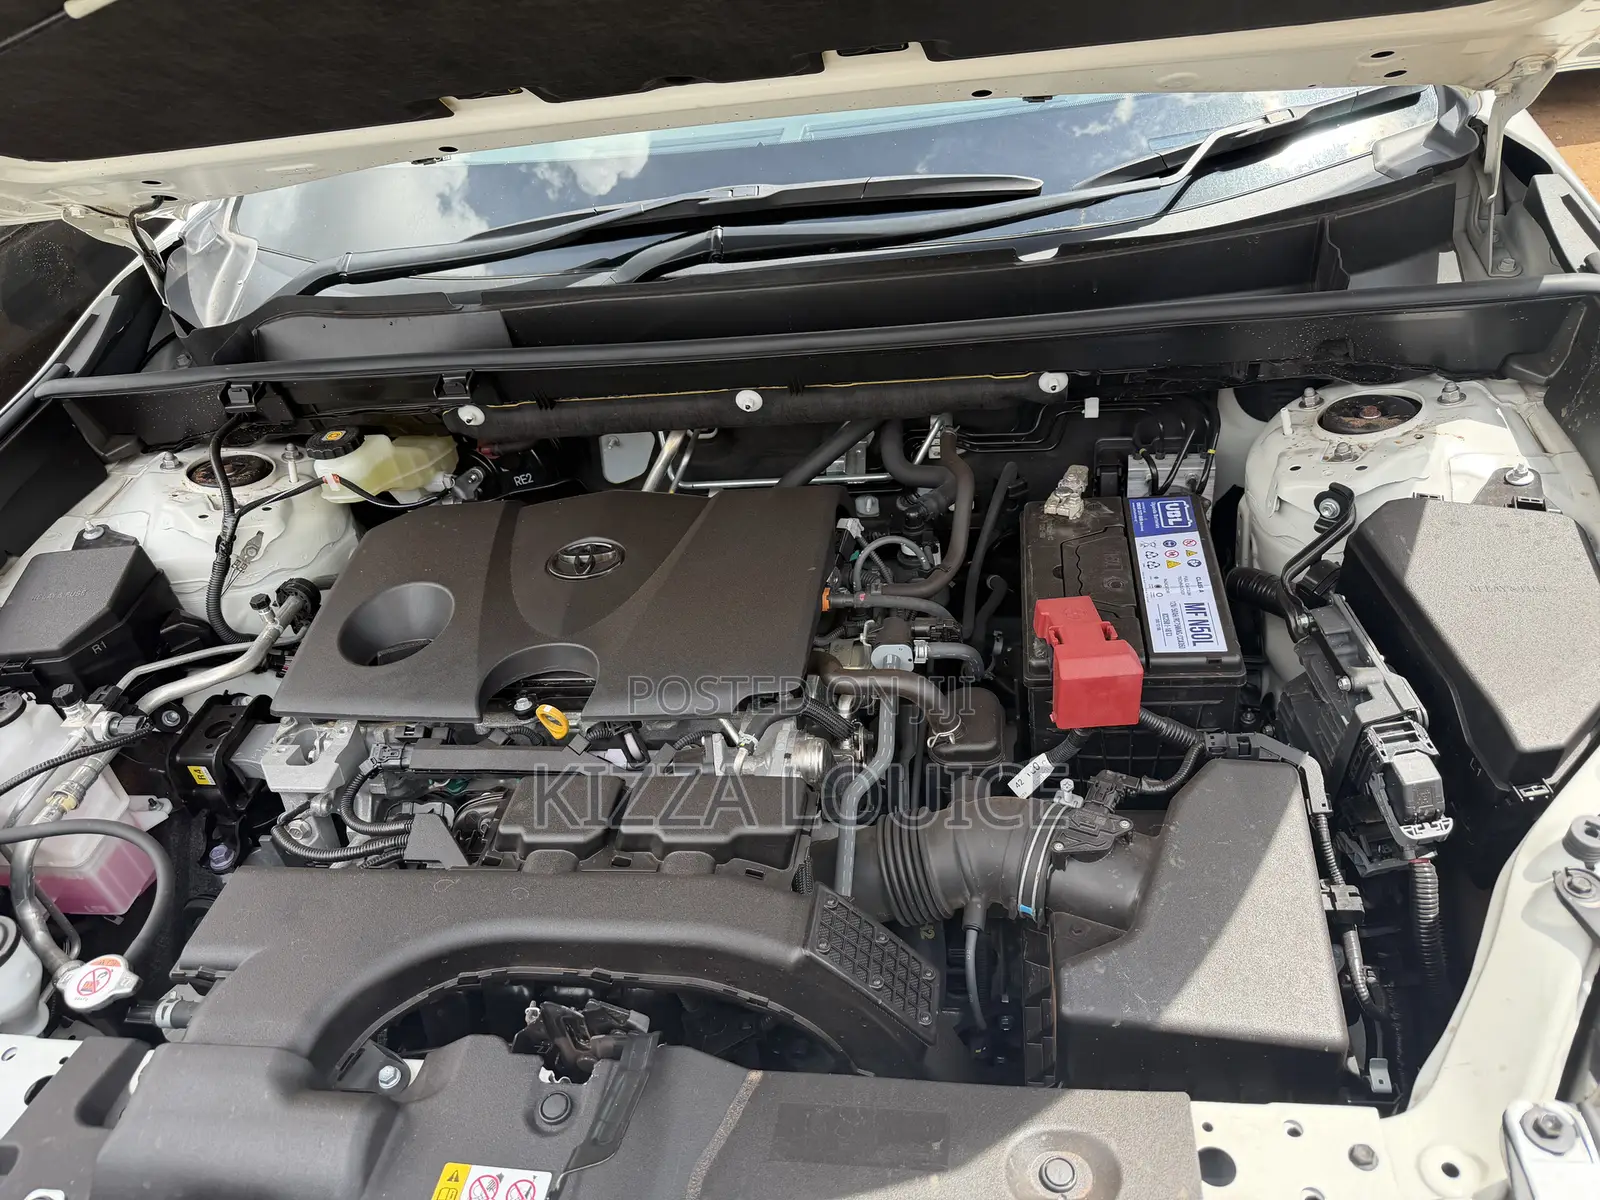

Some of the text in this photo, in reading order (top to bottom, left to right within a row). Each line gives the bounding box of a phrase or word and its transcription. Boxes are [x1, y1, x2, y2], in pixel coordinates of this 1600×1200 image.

[513, 472, 534, 487] RE2
[1165, 502, 1183, 526] UBL
[1183, 602, 1215, 647] MF N50L
[91, 640, 108, 655] R1
